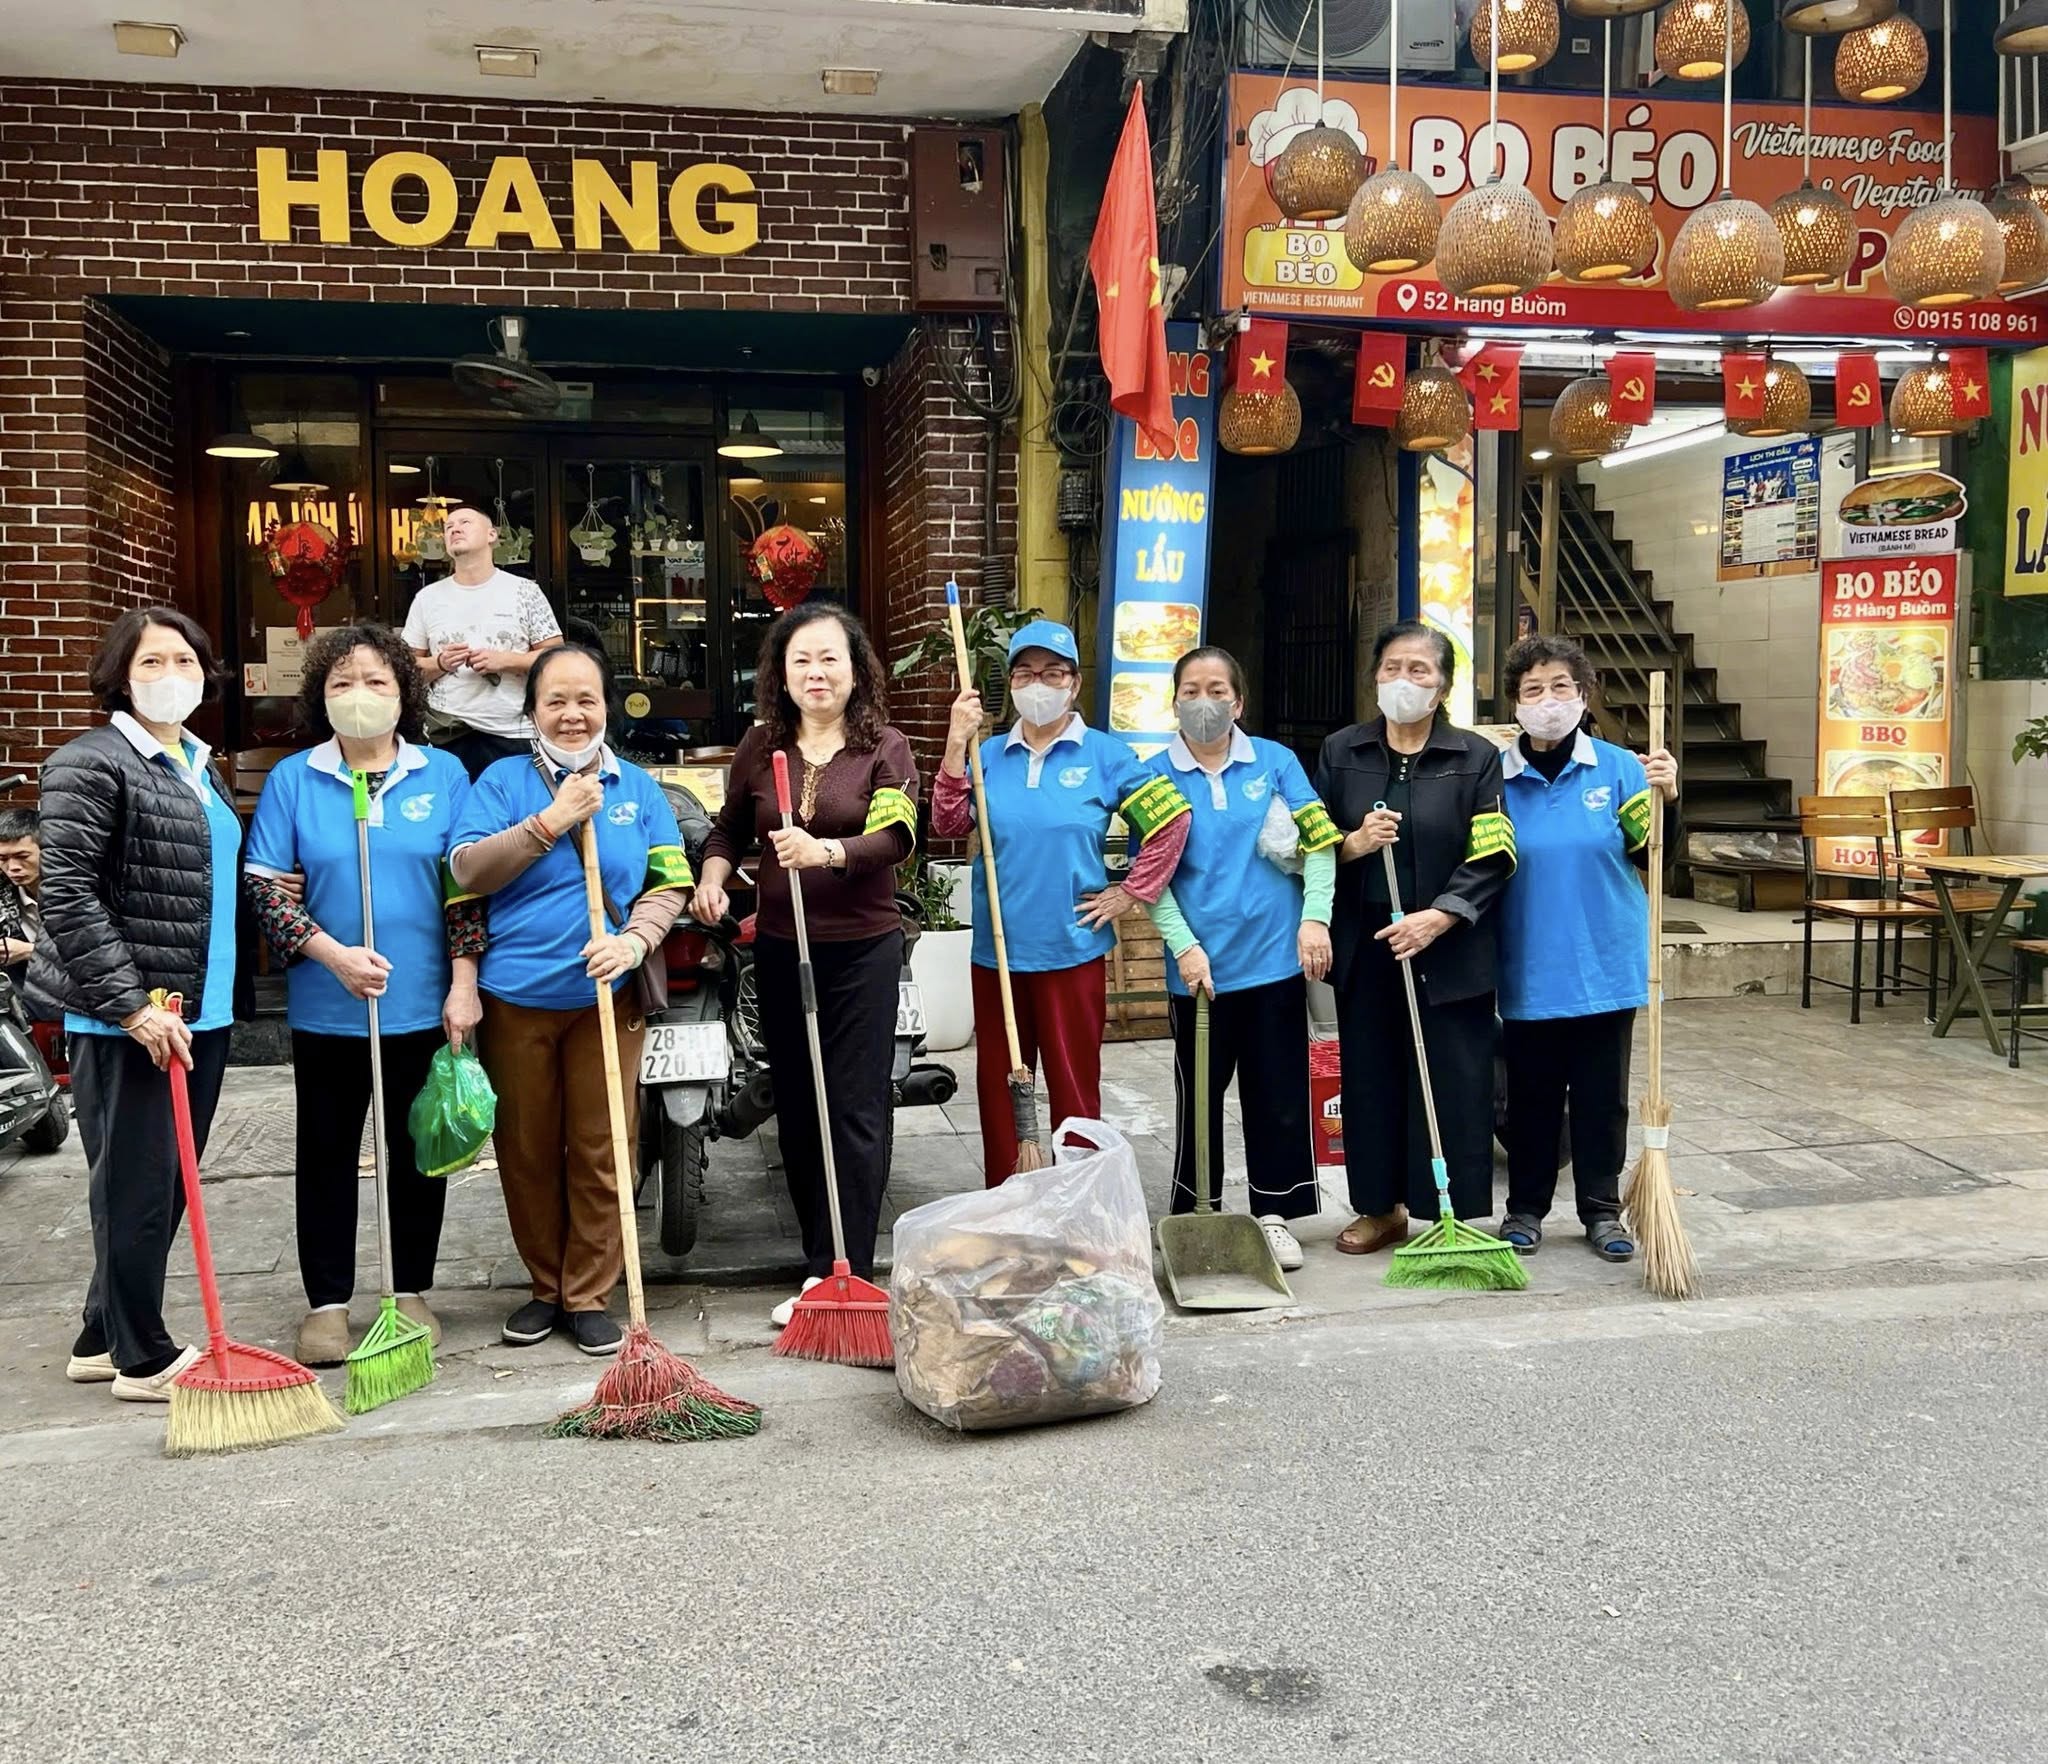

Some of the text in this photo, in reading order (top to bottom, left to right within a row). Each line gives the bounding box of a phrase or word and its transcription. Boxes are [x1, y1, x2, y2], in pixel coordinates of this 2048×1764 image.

[1733, 121, 1957, 165] Vietnamese Food
[1410, 103, 1719, 211] BO BÉO
[256, 147, 759, 256] HOANG
[1286, 233, 1330, 257] BO
[1275, 254, 1338, 286] BÉO
[1242, 291, 1365, 309] VIETNAMESE RESTAURANT
[1423, 291, 1449, 311] 52
[1917, 310, 2038, 333] 0915 108 961
[1134, 417, 1200, 462] BQ
[1849, 527, 1949, 545] VIETNAMESE BREAD
[1835, 561, 1943, 600] BO BÉO
[1832, 600, 1947, 620] 52 Hàng Buồm
[1861, 725, 1908, 745] BBQ
